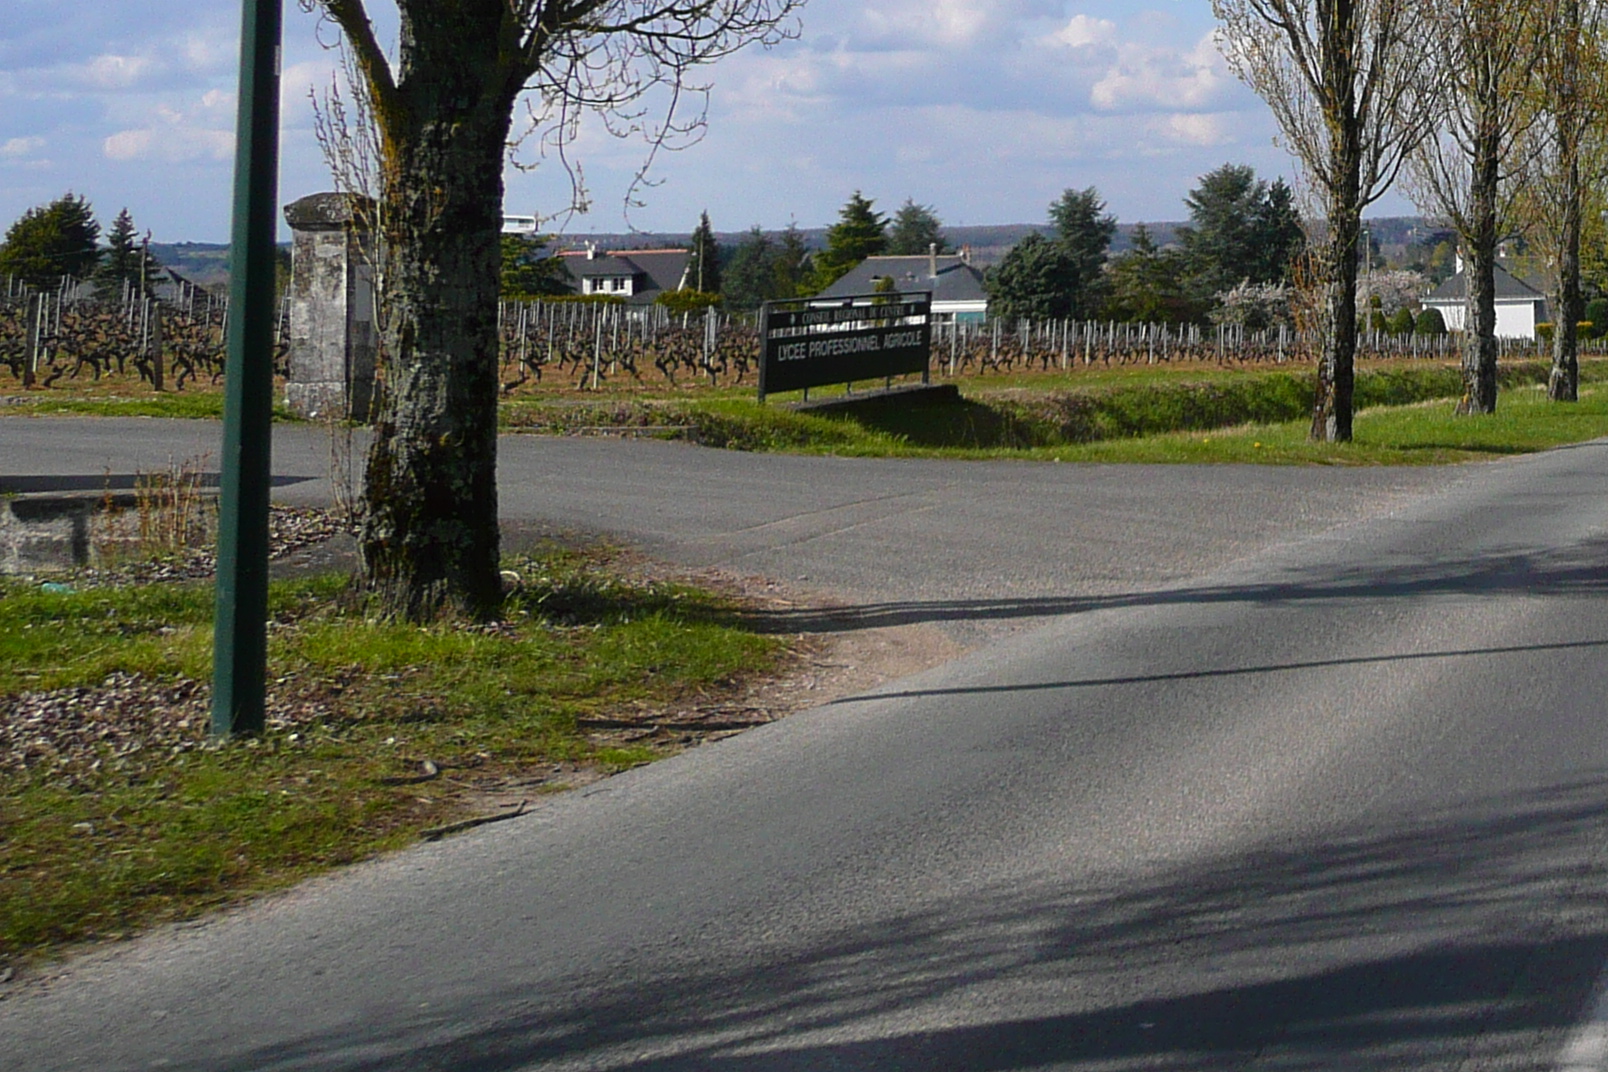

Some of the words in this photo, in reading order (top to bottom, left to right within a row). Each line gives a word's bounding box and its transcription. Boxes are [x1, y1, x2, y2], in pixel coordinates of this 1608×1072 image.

[778, 341, 806, 361] LYCEE
[808, 335, 880, 357] PROFESSIONNEL
[883, 330, 922, 348] AGRICOLE
